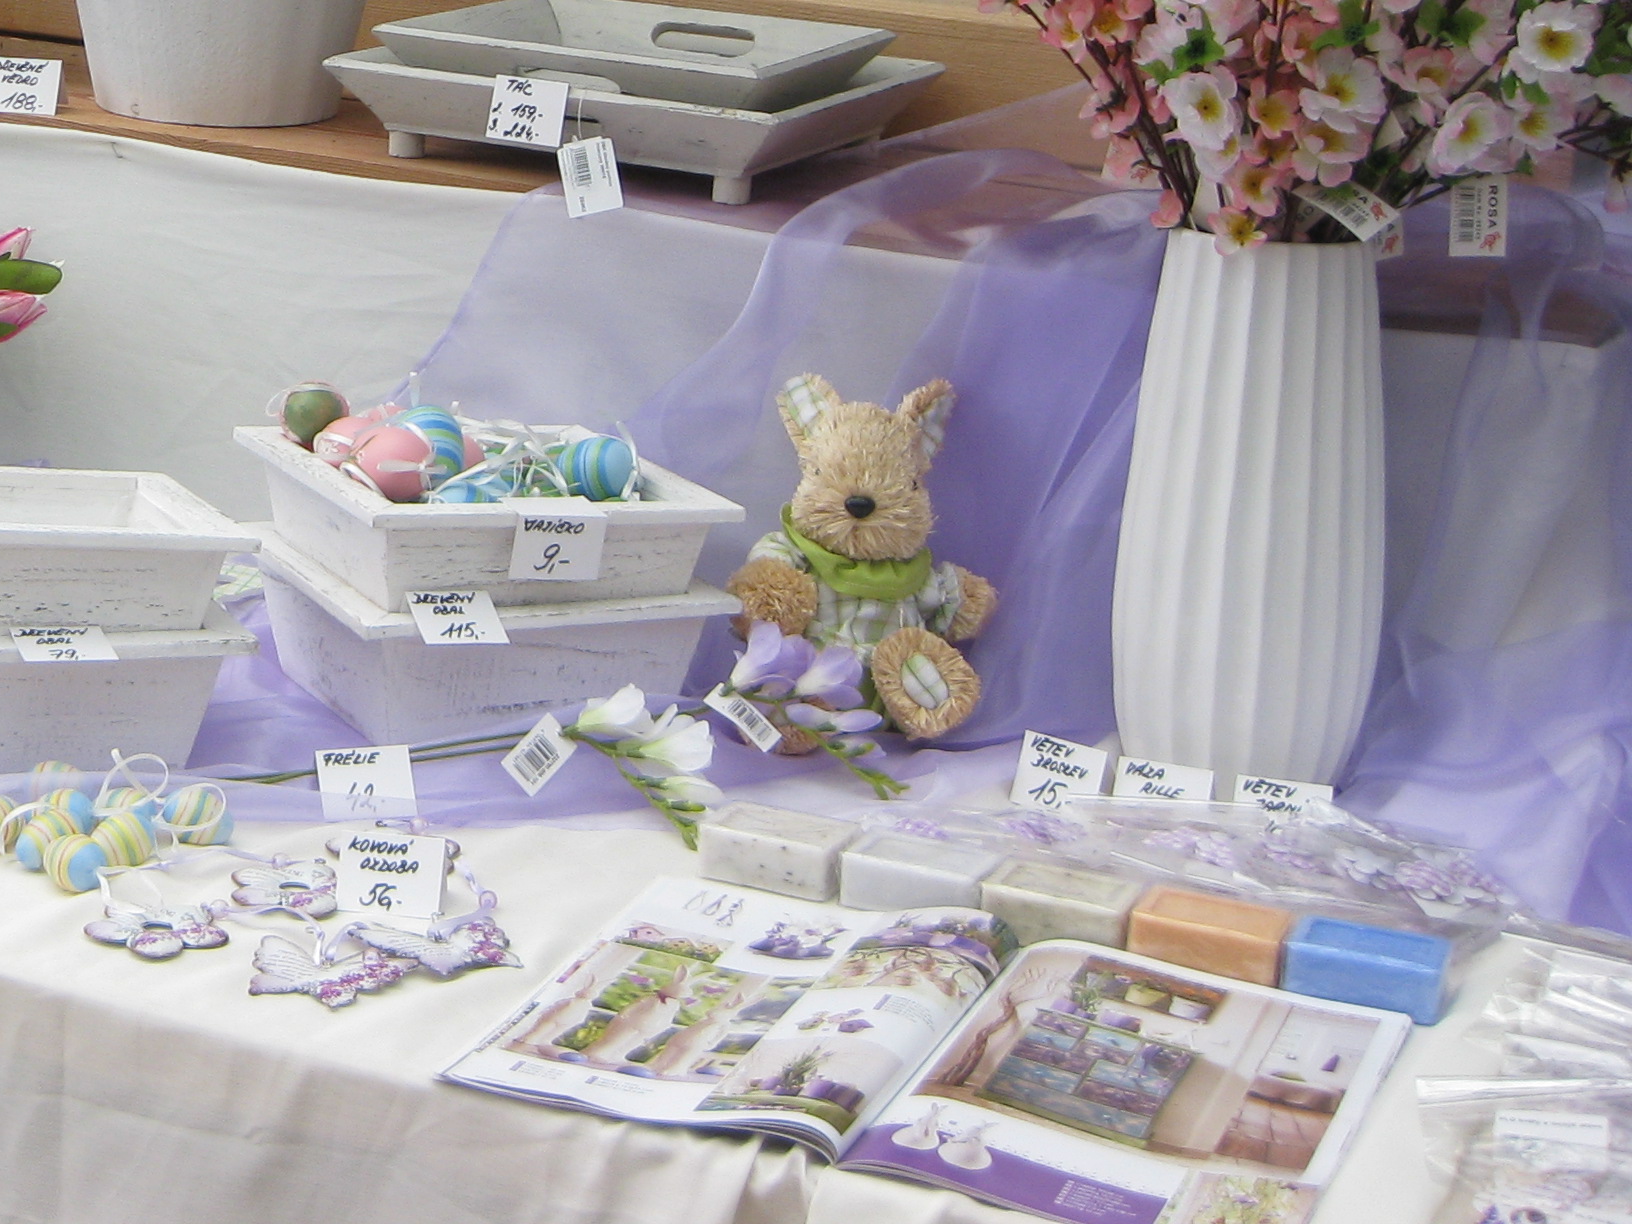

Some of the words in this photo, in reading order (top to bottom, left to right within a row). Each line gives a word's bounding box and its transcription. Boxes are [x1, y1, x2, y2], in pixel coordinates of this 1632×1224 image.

[506, 79, 533, 96] TÁC
[1487, 185, 1499, 228] ROSA
[533, 543, 570, 574] 9,-
[347, 835, 414, 855] KOVOVÁ
